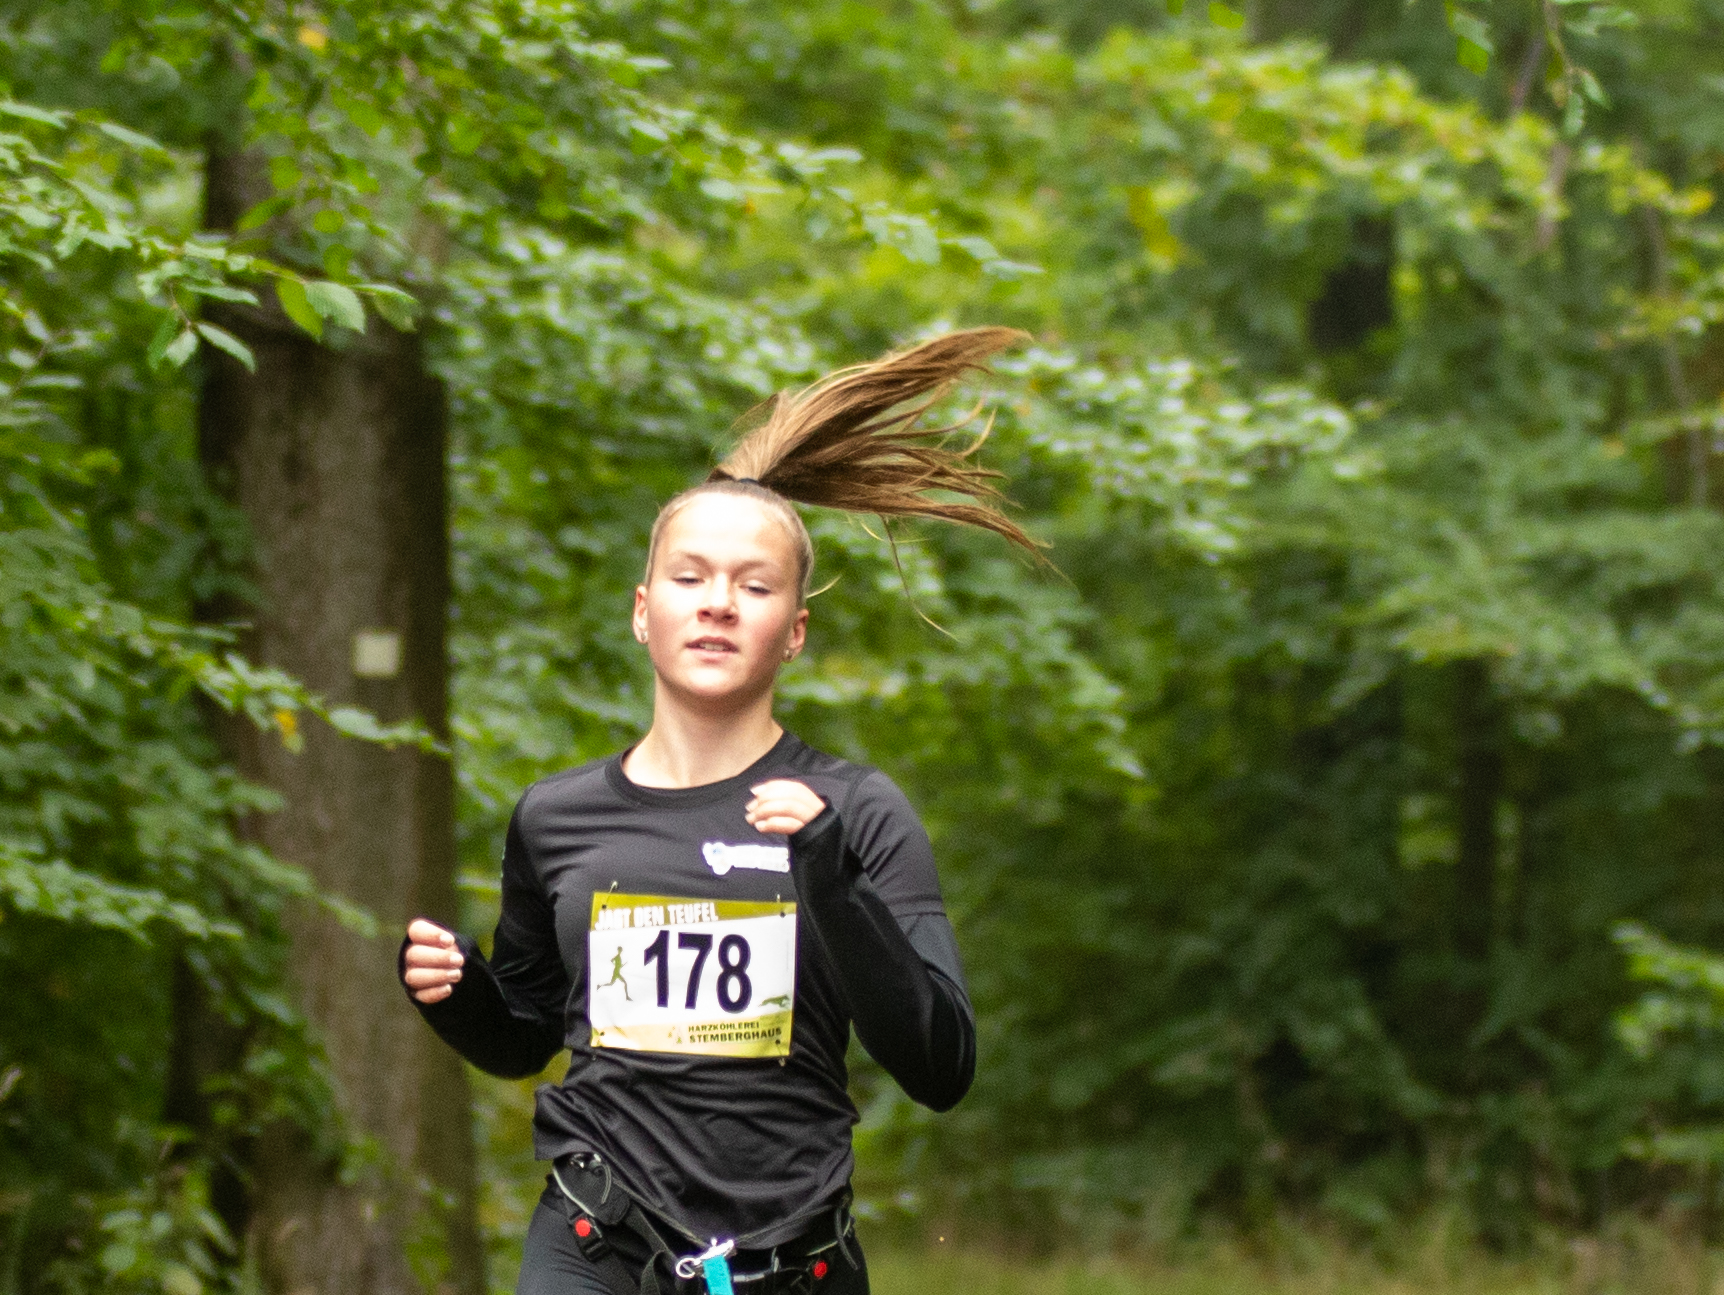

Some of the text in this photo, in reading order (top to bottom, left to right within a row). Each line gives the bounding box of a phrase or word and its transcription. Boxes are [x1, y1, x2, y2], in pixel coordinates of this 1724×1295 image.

[634, 905, 665, 928] DEN
[667, 902, 719, 925] TEUFEL
[643, 929, 752, 1014] 178
[688, 1027, 782, 1044] STEMBERGHAUS
